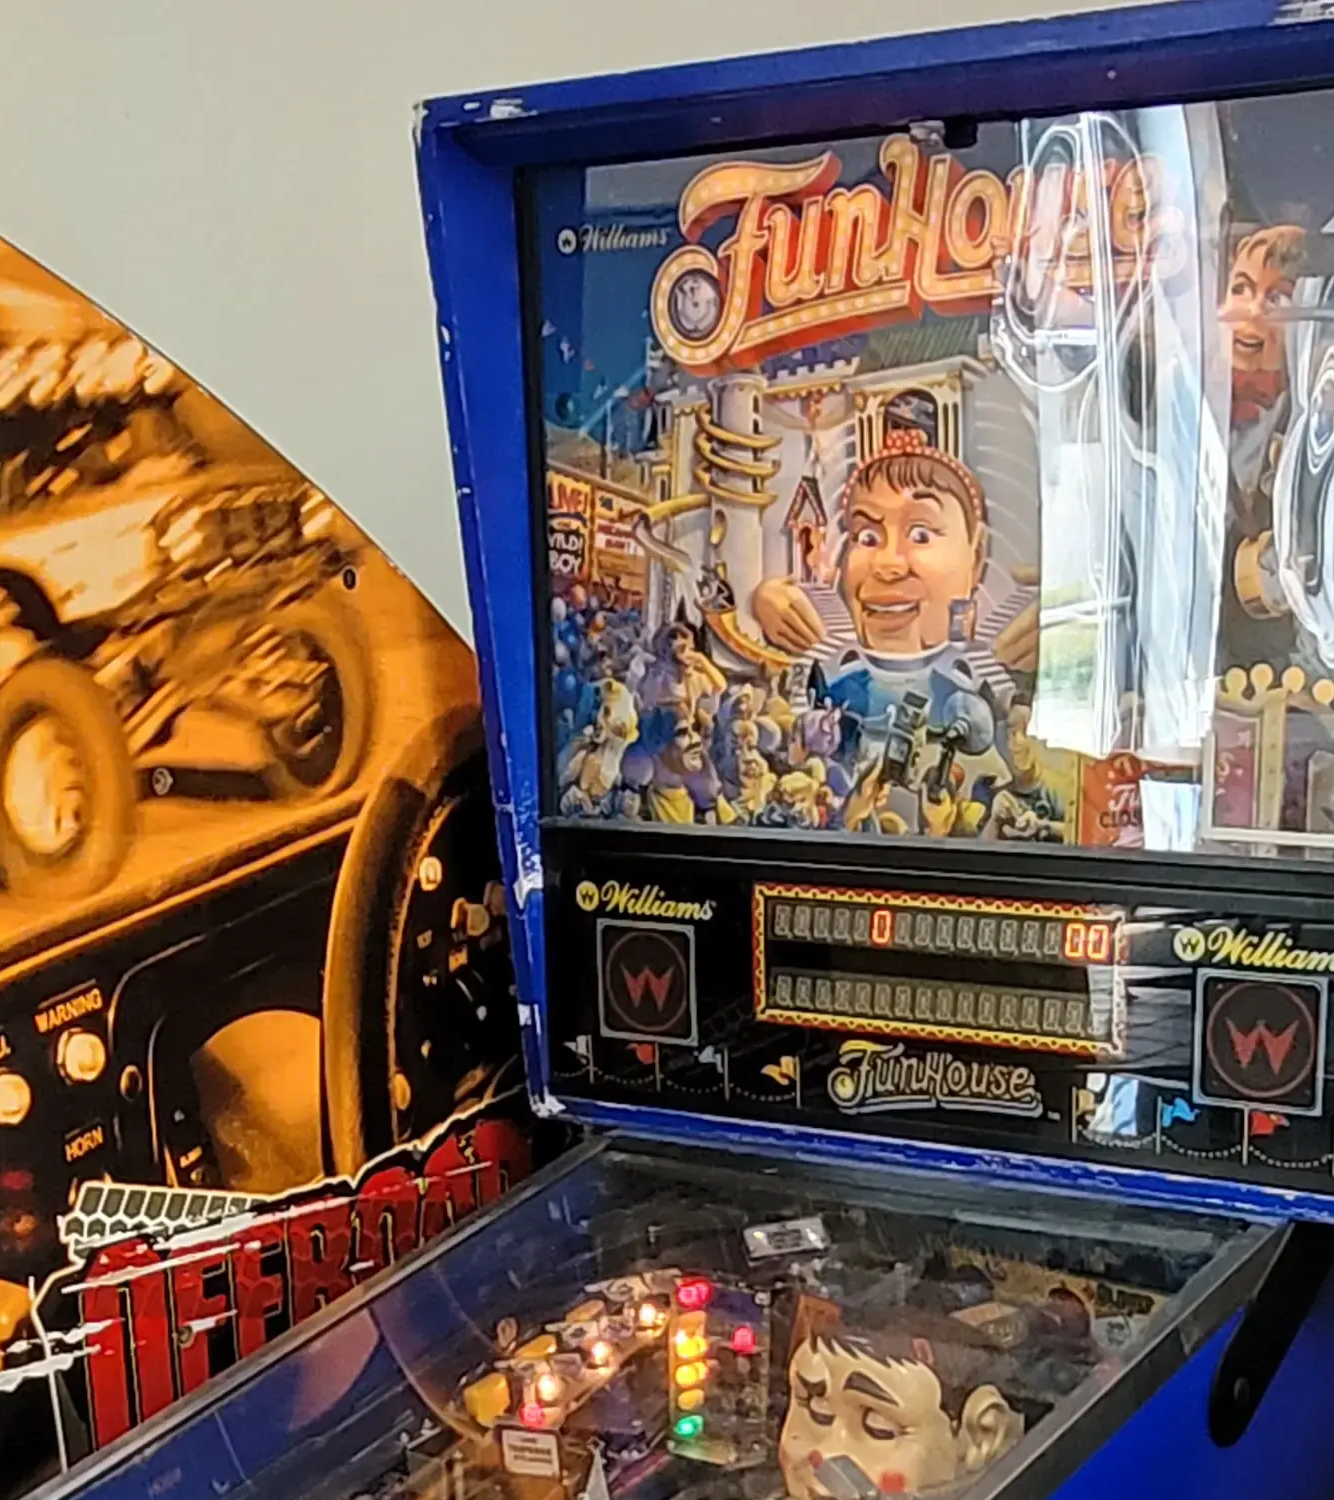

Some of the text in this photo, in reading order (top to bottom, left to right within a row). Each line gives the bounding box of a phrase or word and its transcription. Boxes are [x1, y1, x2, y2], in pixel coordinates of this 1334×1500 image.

[577, 221, 670, 253] Williams
[601, 881, 714, 922] Williams
[35, 989, 103, 1034] WARNING
[828, 1040, 1045, 1116] FunHouse
[65, 1127, 105, 1163] HORN
